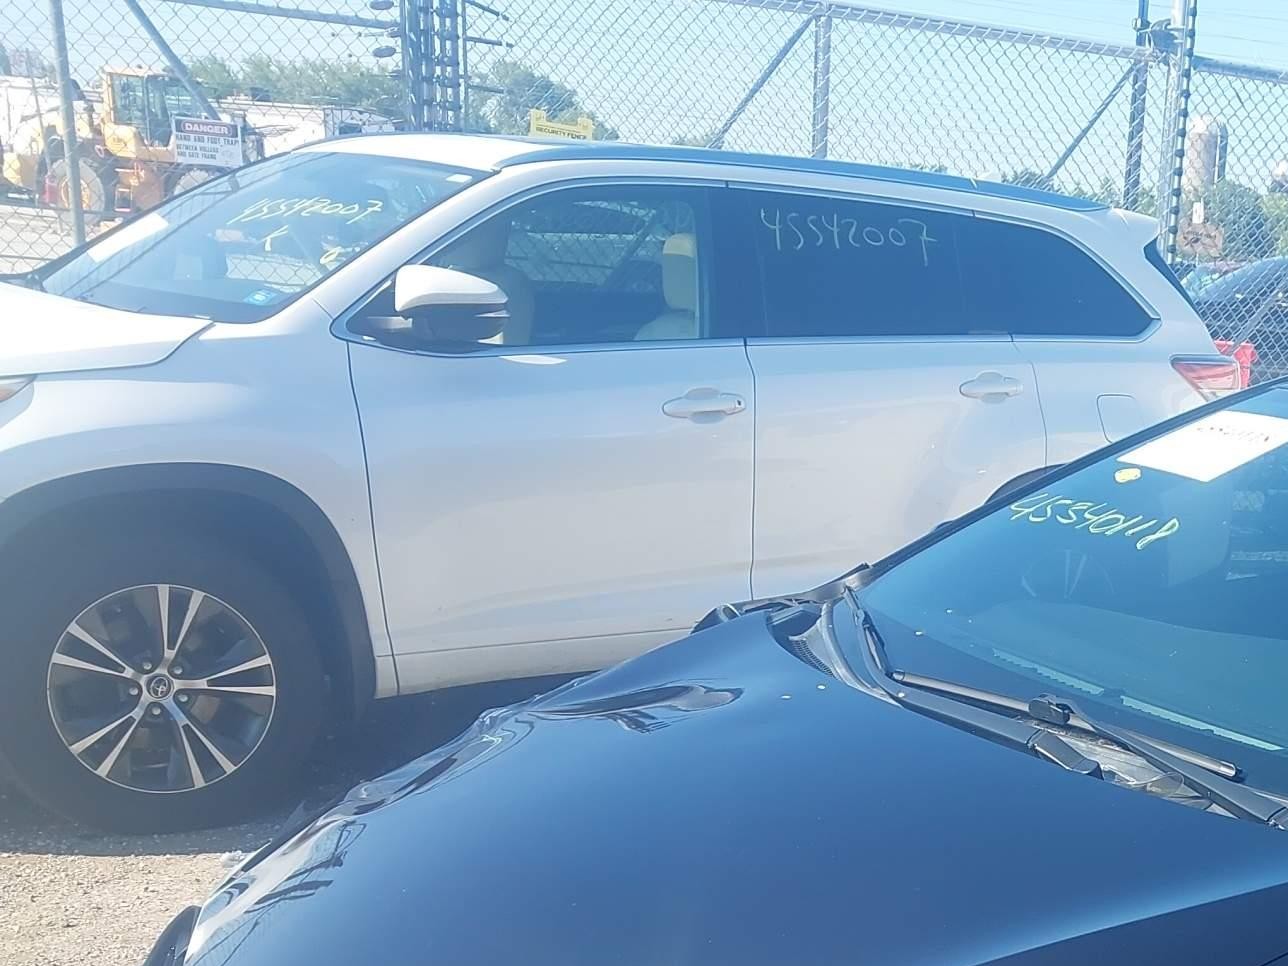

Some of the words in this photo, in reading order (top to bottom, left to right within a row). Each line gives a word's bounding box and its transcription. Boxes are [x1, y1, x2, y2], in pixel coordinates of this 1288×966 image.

[184, 122, 229, 135] DANGER
[535, 126, 566, 136] SECURITY
[760, 207, 938, 267] 45542007
[1010, 493, 1180, 550] 45540118
